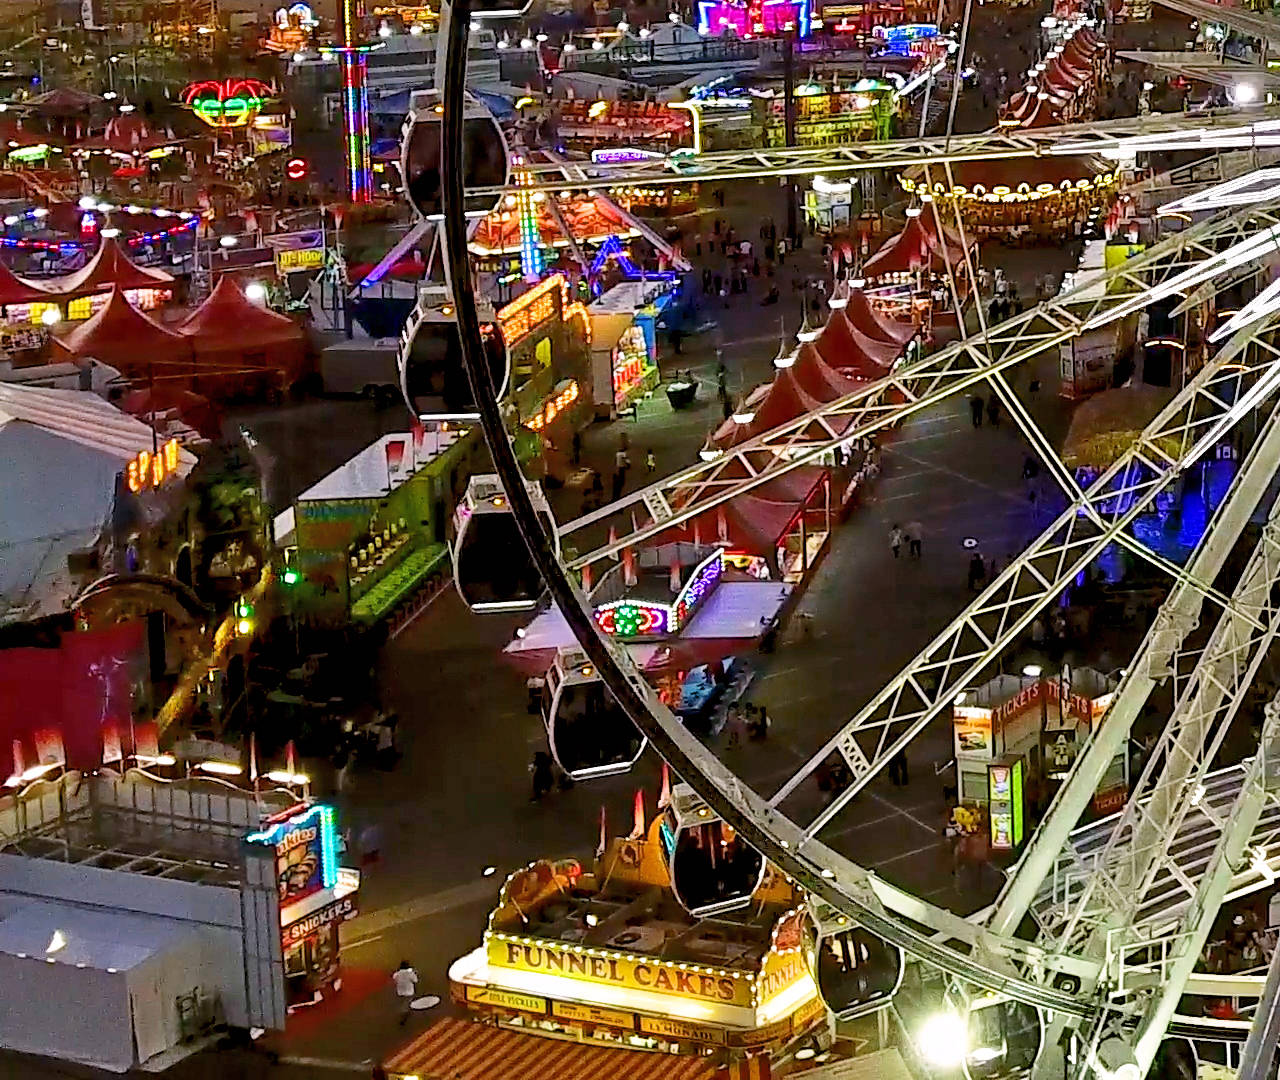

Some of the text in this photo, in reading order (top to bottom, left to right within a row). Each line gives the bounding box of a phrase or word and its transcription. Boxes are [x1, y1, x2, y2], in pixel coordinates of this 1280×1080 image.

[995, 683, 1040, 719] TICKETS
[1048, 680, 1089, 714] TITS
[1054, 733, 1069, 767] ATM
[291, 899, 352, 939] SNICKERS
[506, 942, 735, 1001] FUNNEL CAKES
